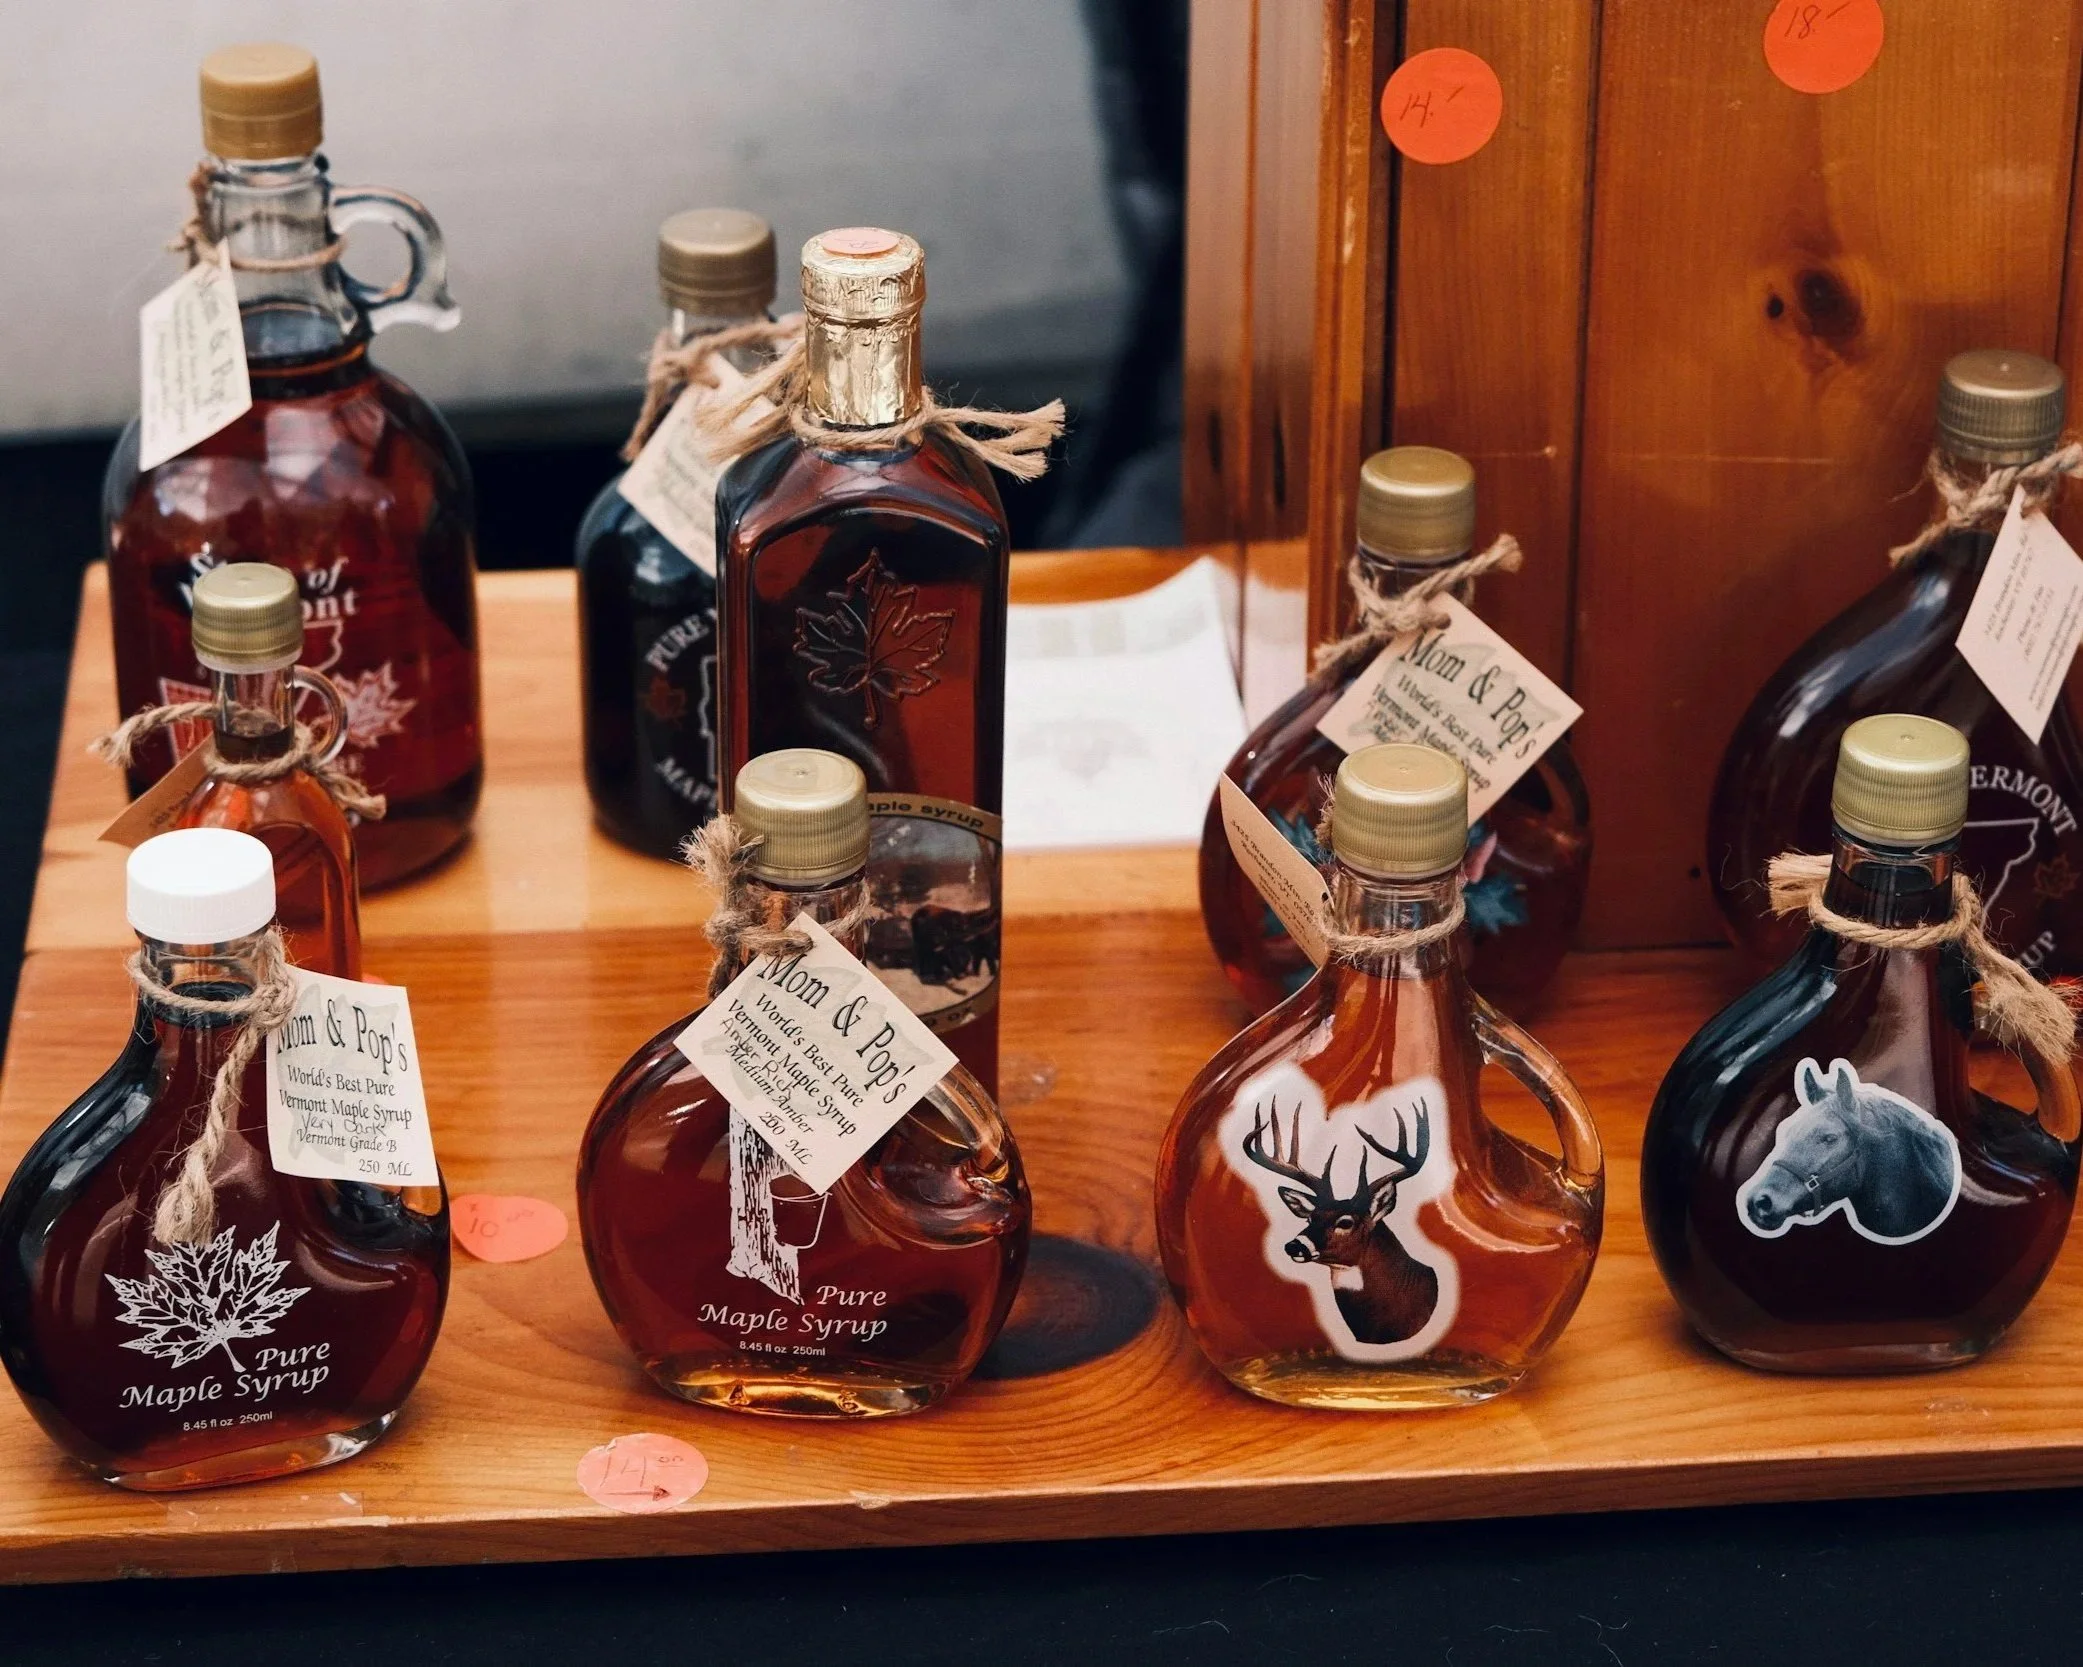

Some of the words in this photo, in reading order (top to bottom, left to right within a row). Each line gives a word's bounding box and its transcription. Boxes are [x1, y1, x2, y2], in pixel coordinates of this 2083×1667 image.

[307, 556, 349, 594] of
[1372, 683, 1421, 730] Vermont
[1398, 629, 1466, 683] Mom
[1467, 664, 1501, 705] &
[1490, 685, 1545, 760] Pop's
[1398, 674, 1444, 718] World's
[1440, 714, 1470, 742] Best
[1467, 735, 1498, 766] Pure
[921, 805, 984, 829] syrup
[1970, 765, 2078, 837] ERMONT
[277, 1014, 317, 1054] Mom
[326, 998, 346, 1048] &
[352, 1005, 408, 1076] Pop's
[757, 953, 830, 1010] Mom
[832, 995, 869, 1038] &
[856, 1021, 916, 1105] Pop's
[728, 999, 782, 1057] Vermont
[779, 1052, 820, 1098] Maple
[817, 1095, 857, 1139] Syrup
[756, 993, 805, 1047] World's
[802, 1043, 835, 1077] Best
[831, 1072, 864, 1108] Pure
[287, 1064, 332, 1088] World's
[336, 1073, 362, 1093] Best
[366, 1078, 396, 1097] Pure
[725, 1044, 775, 1096] Medium
[772, 1095, 814, 1134] Amber
[760, 1060, 793, 1102] Rich
[279, 1089, 328, 1114] Vermont
[332, 1098, 369, 1124] Maple
[373, 1104, 412, 1130] Syrup
[296, 1128, 346, 1148] Vermont
[349, 1135, 382, 1153] Grade
[386, 1139, 397, 1152] B
[785, 1139, 813, 1165] ML
[359, 1158, 380, 1174] 250
[387, 1161, 413, 1176] ML
[816, 1285, 887, 1307] Pure
[697, 1303, 789, 1335] Maple
[798, 1312, 888, 1343] Syrup
[254, 1342, 331, 1372] Pure
[739, 1340, 762, 1352] 8.45
[765, 1342, 772, 1352] fl
[774, 1344, 787, 1354] oz
[793, 1345, 826, 1356] 250ml
[118, 1375, 223, 1413] Maple
[233, 1365, 330, 1403] Syrup
[183, 1420, 207, 1432] 8.45
[210, 1418, 218, 1429] fl
[220, 1418, 234, 1428] oz
[239, 1410, 273, 1425] 250ml
